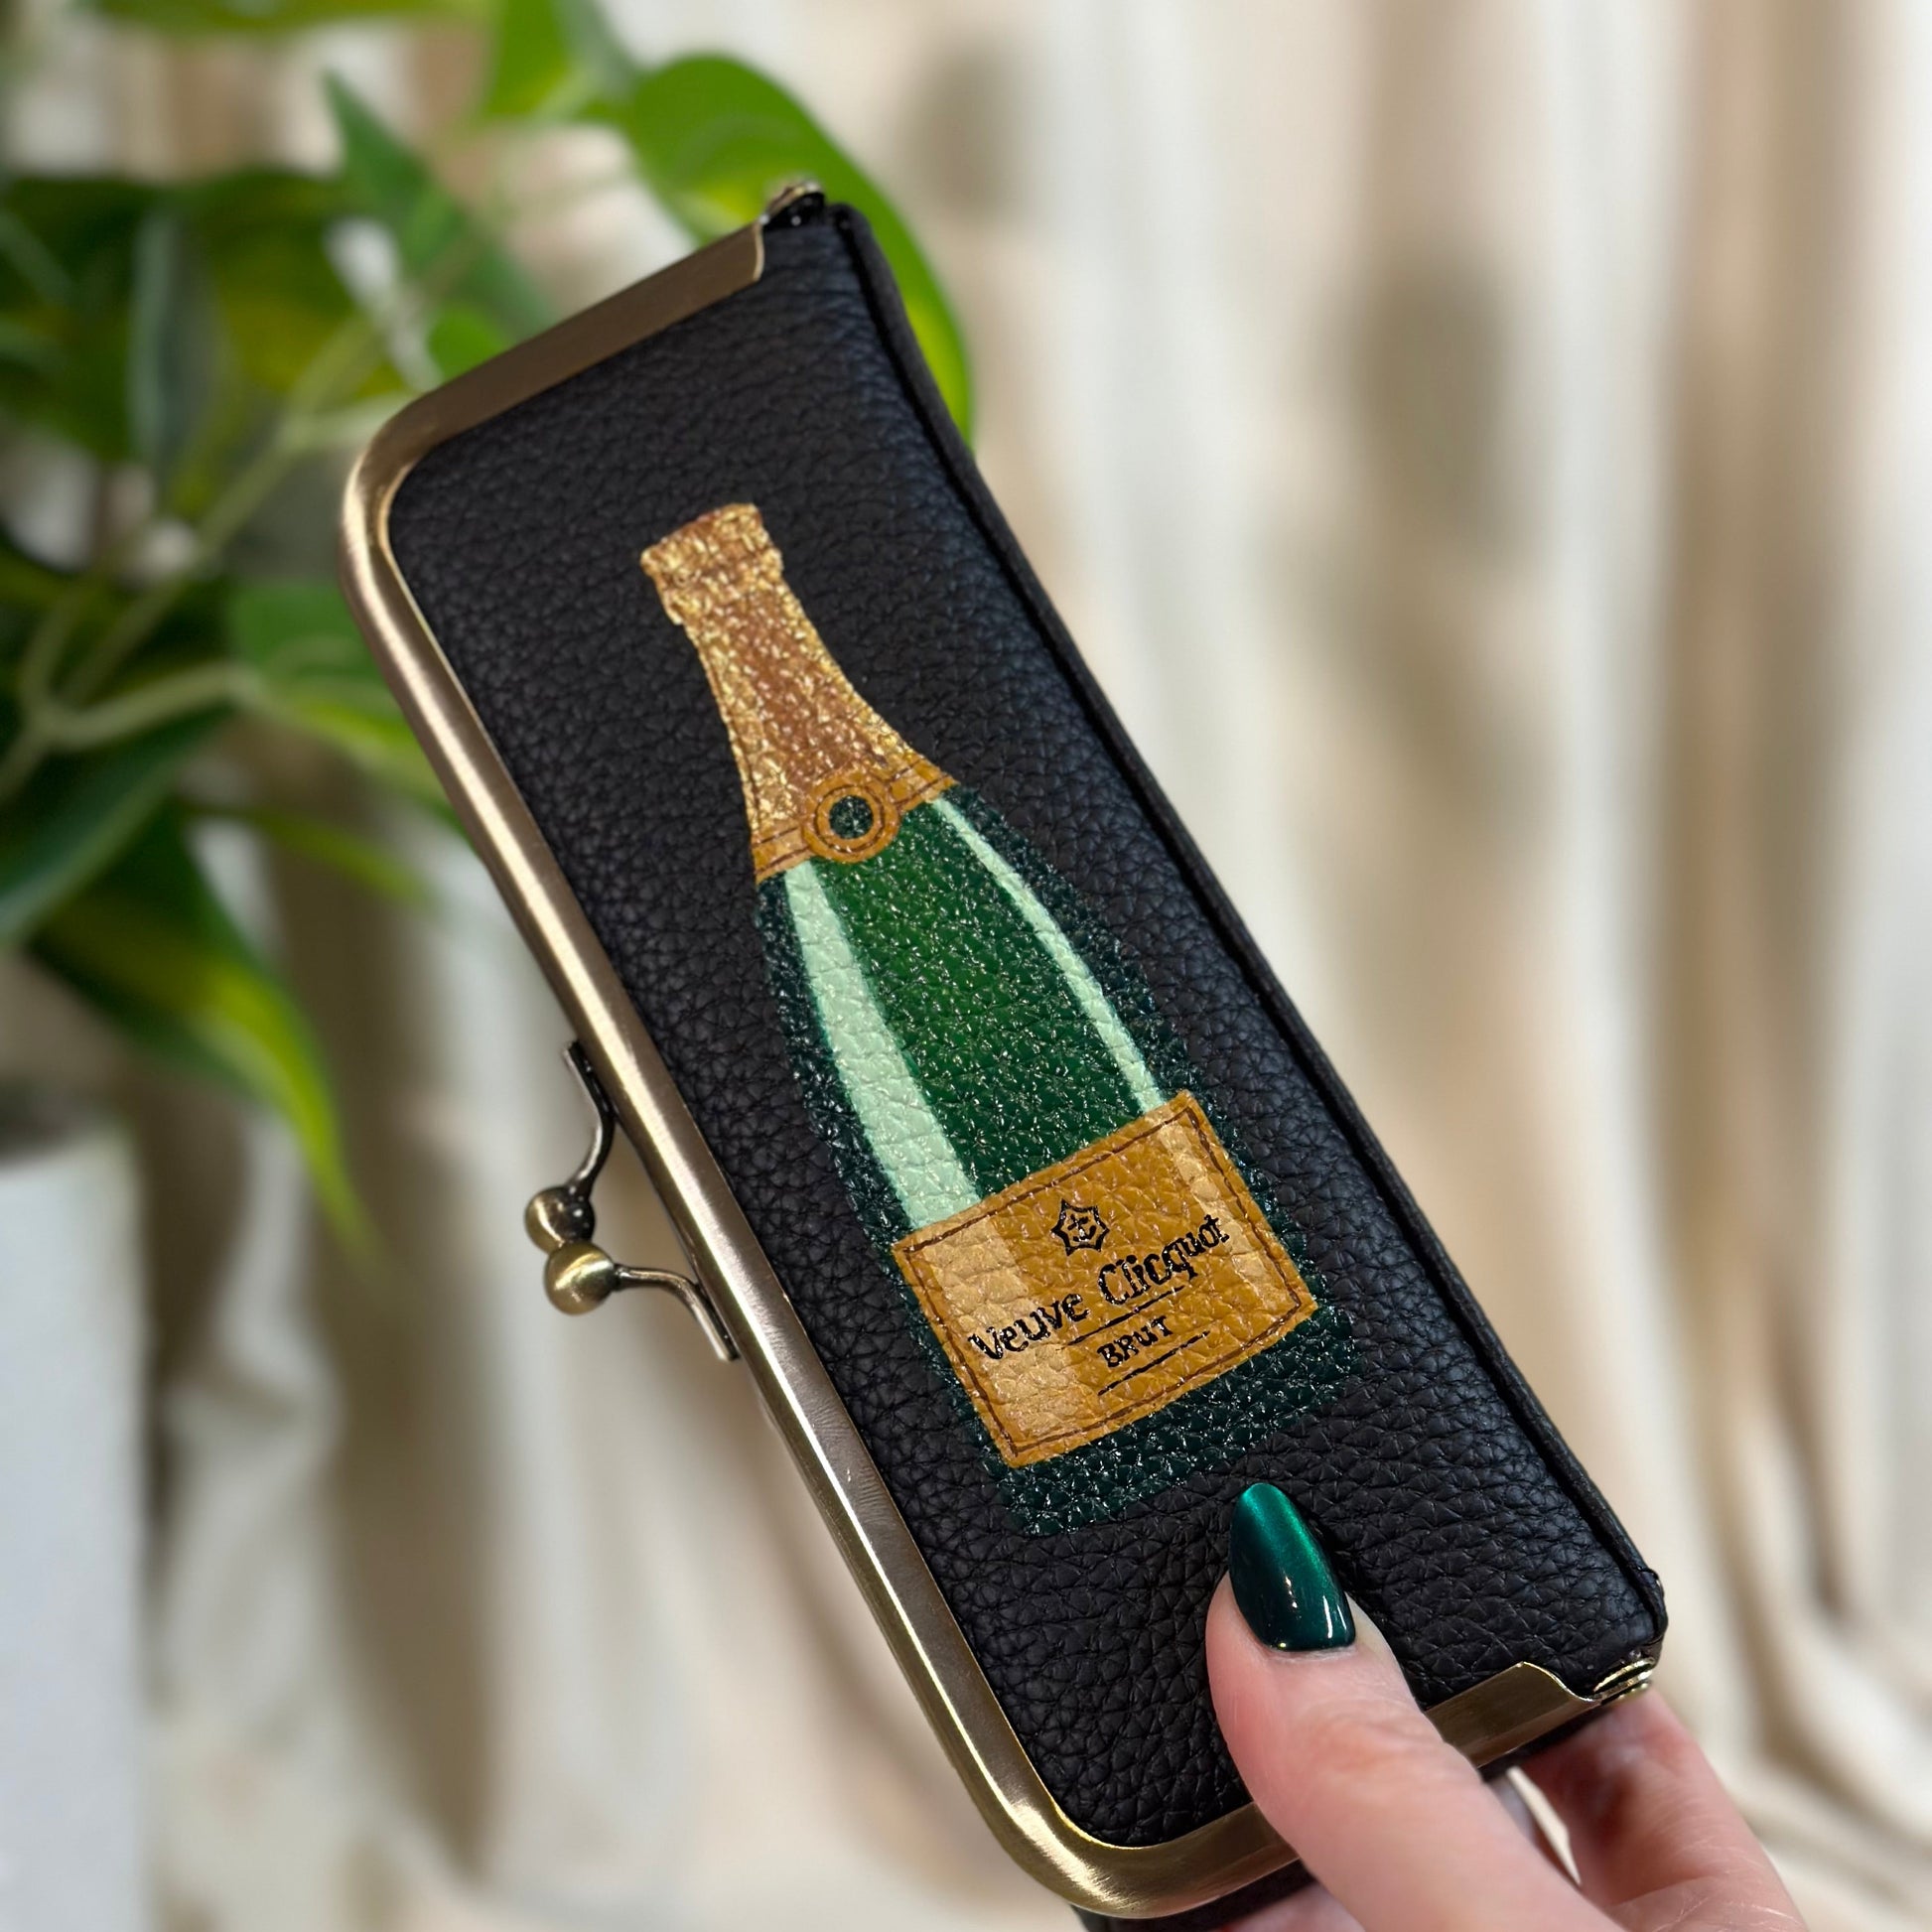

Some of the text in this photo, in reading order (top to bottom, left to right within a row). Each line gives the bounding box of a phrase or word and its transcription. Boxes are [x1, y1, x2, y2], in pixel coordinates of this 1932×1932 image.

[968, 1214, 1230, 1360] Veuve Clicquot
[1096, 1315, 1173, 1368] BRUT
